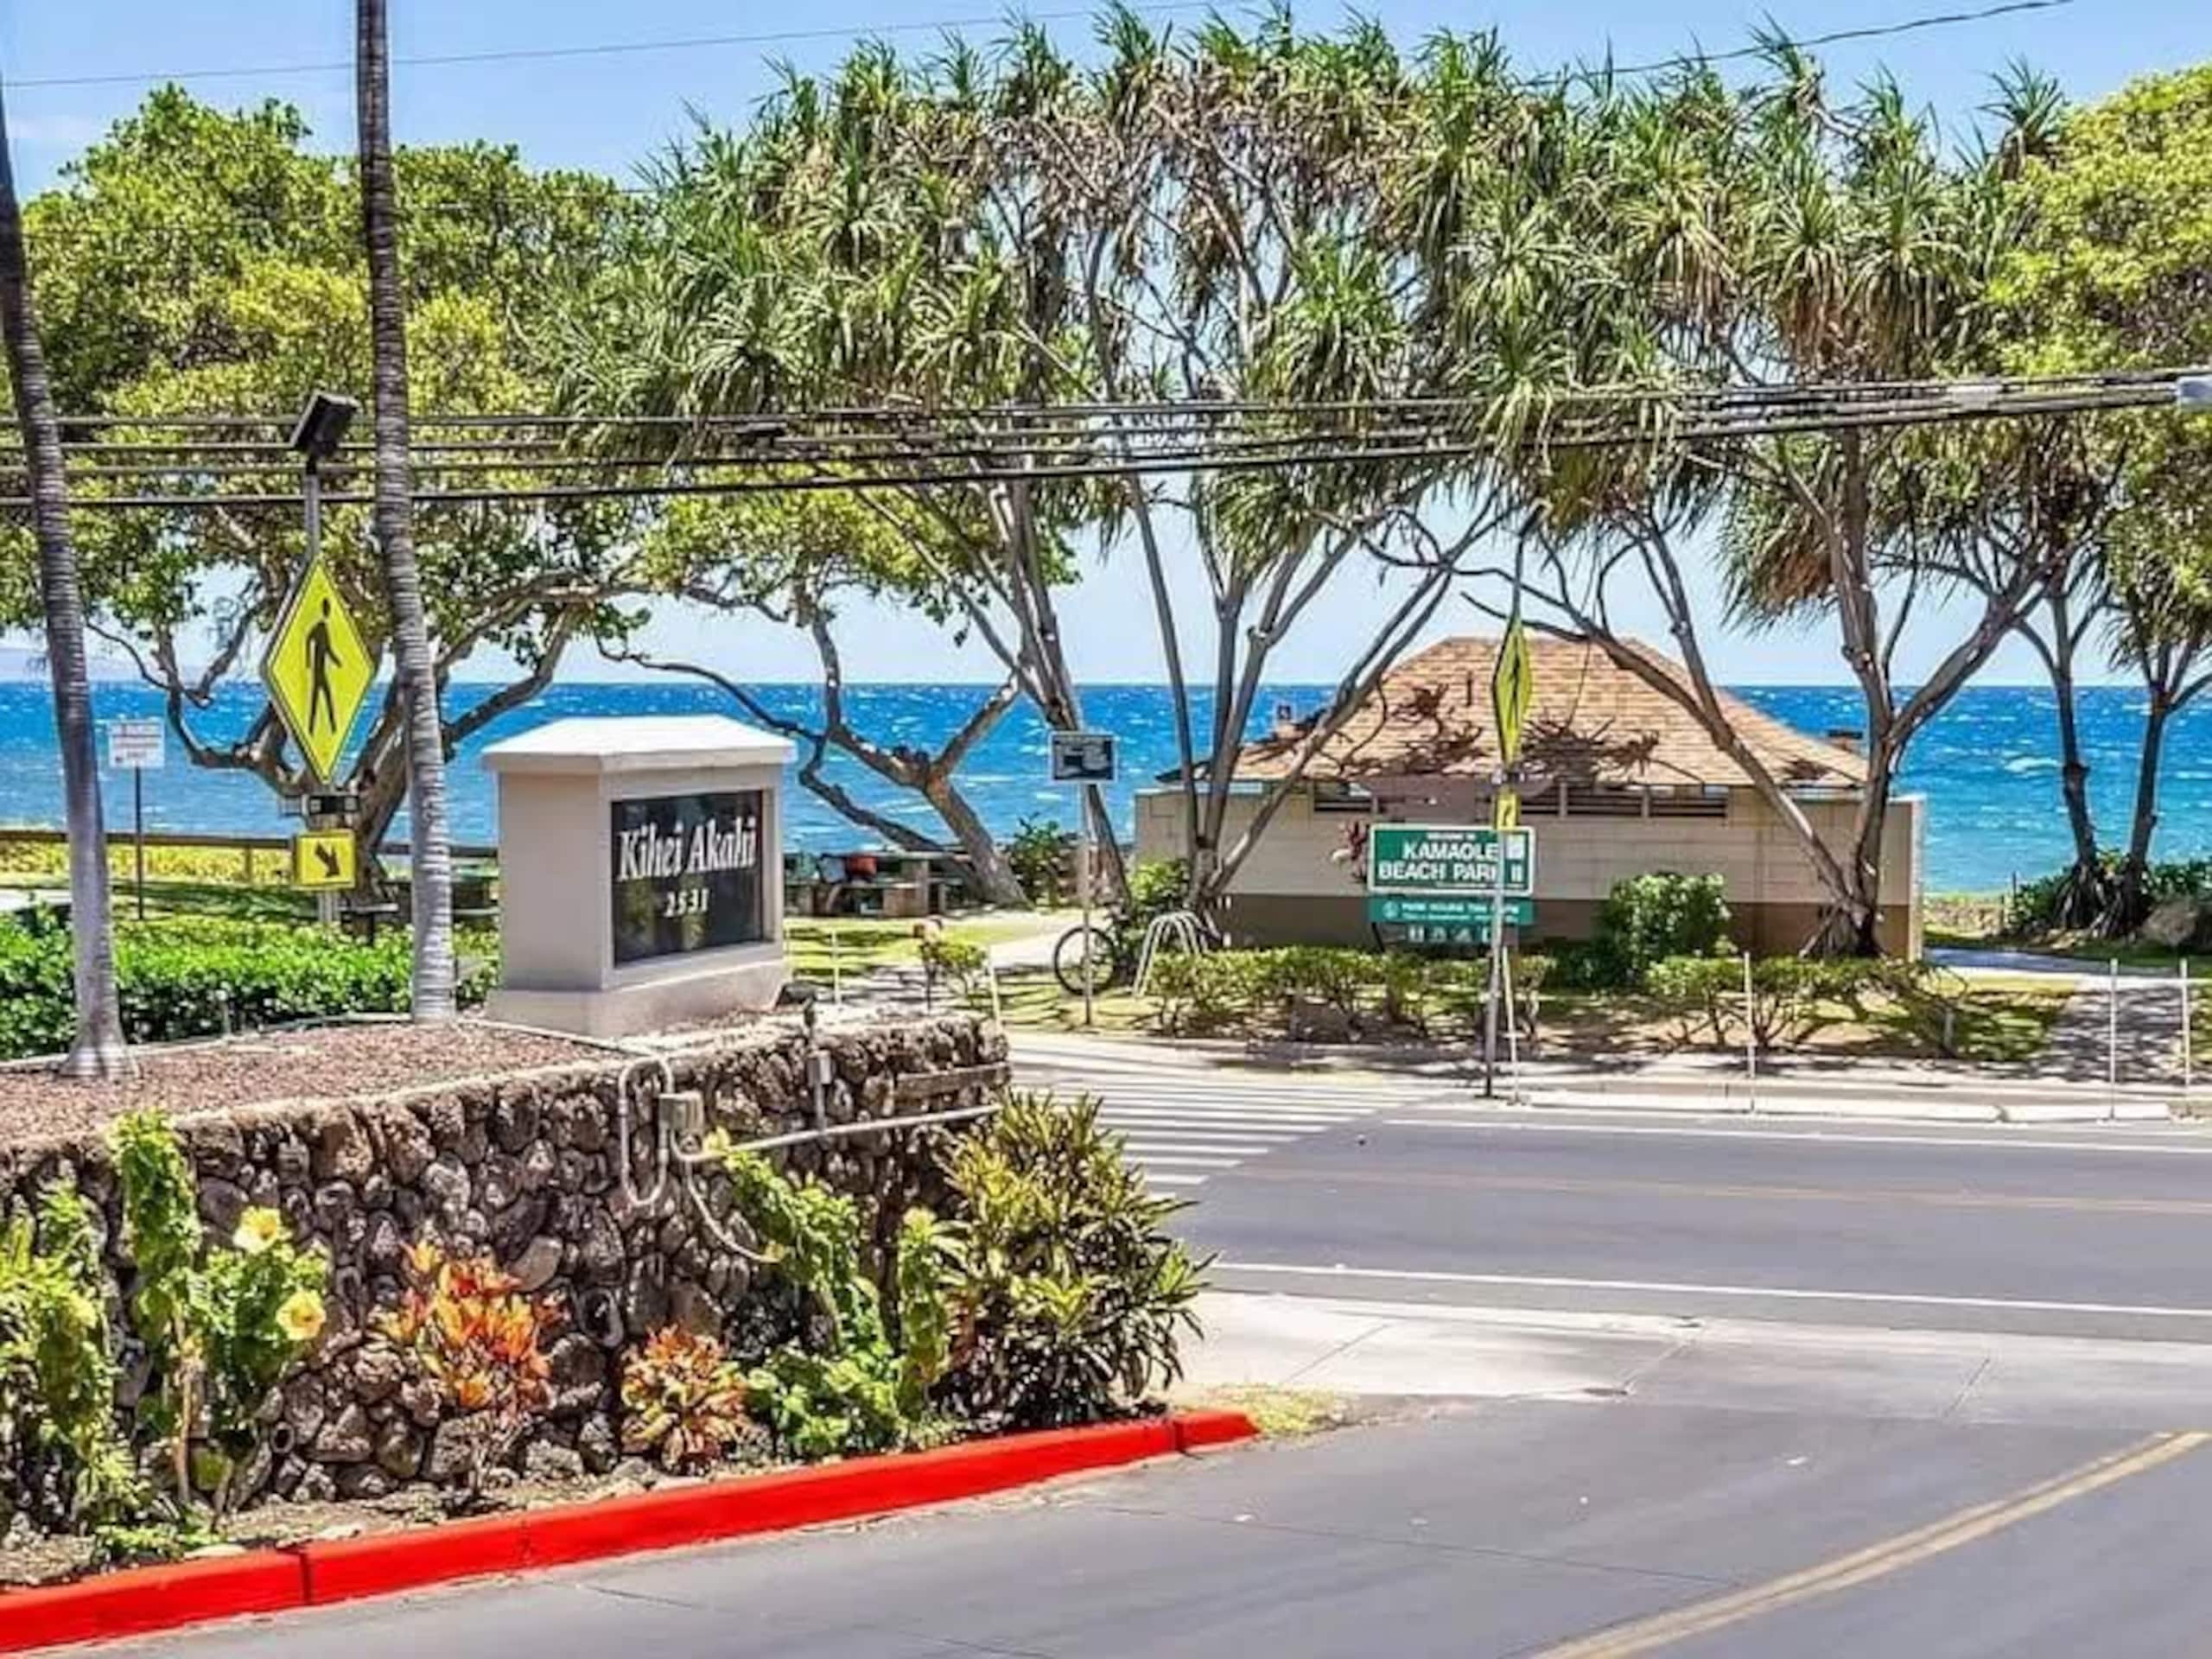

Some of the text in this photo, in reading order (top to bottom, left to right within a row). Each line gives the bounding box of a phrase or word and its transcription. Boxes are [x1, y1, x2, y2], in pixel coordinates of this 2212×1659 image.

[618, 817, 756, 881] Kihei Akahi
[1402, 842, 1499, 861] KAMAOLE
[1379, 861, 1446, 880] BEACH
[664, 888, 709, 918] 2531
